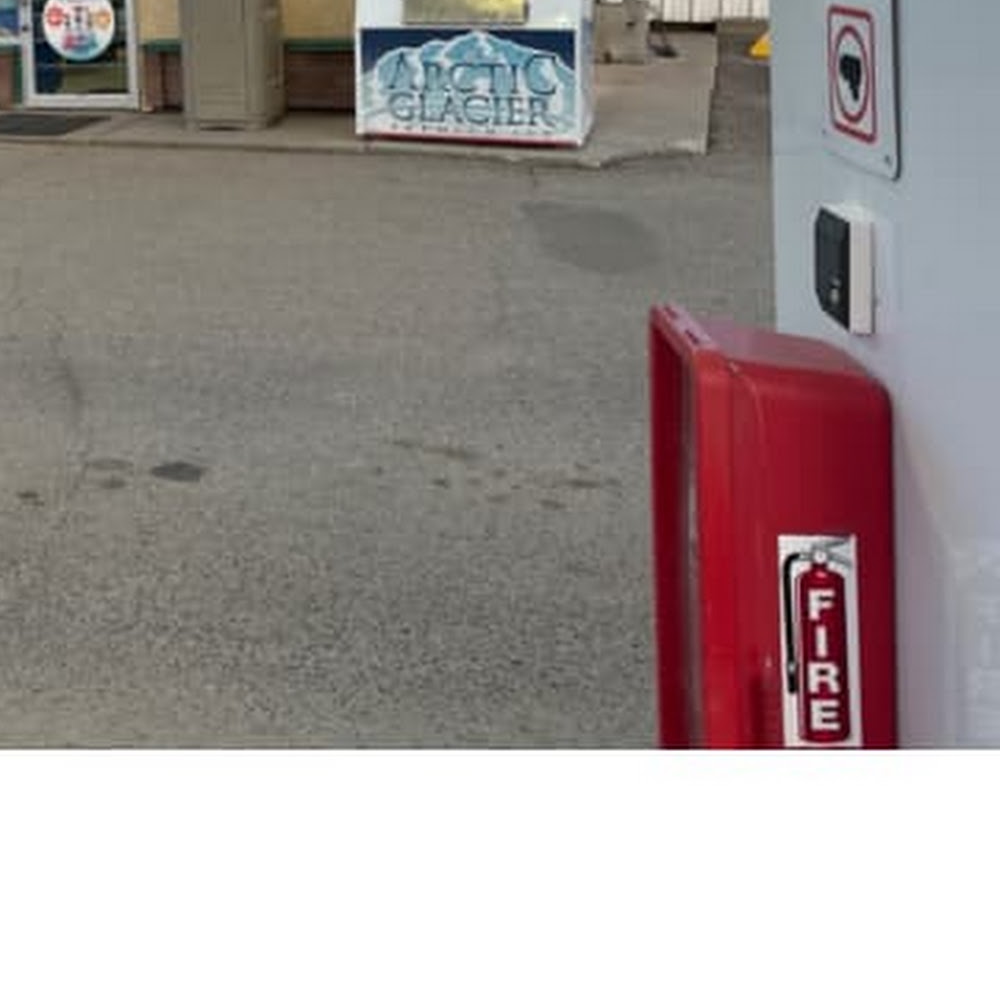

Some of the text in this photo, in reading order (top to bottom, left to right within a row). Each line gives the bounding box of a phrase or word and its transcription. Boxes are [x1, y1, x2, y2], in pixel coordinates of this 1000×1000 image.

[387, 51, 558, 96] ARCTIC
[388, 93, 557, 126] GLACIER
[808, 588, 841, 731] FIRE
